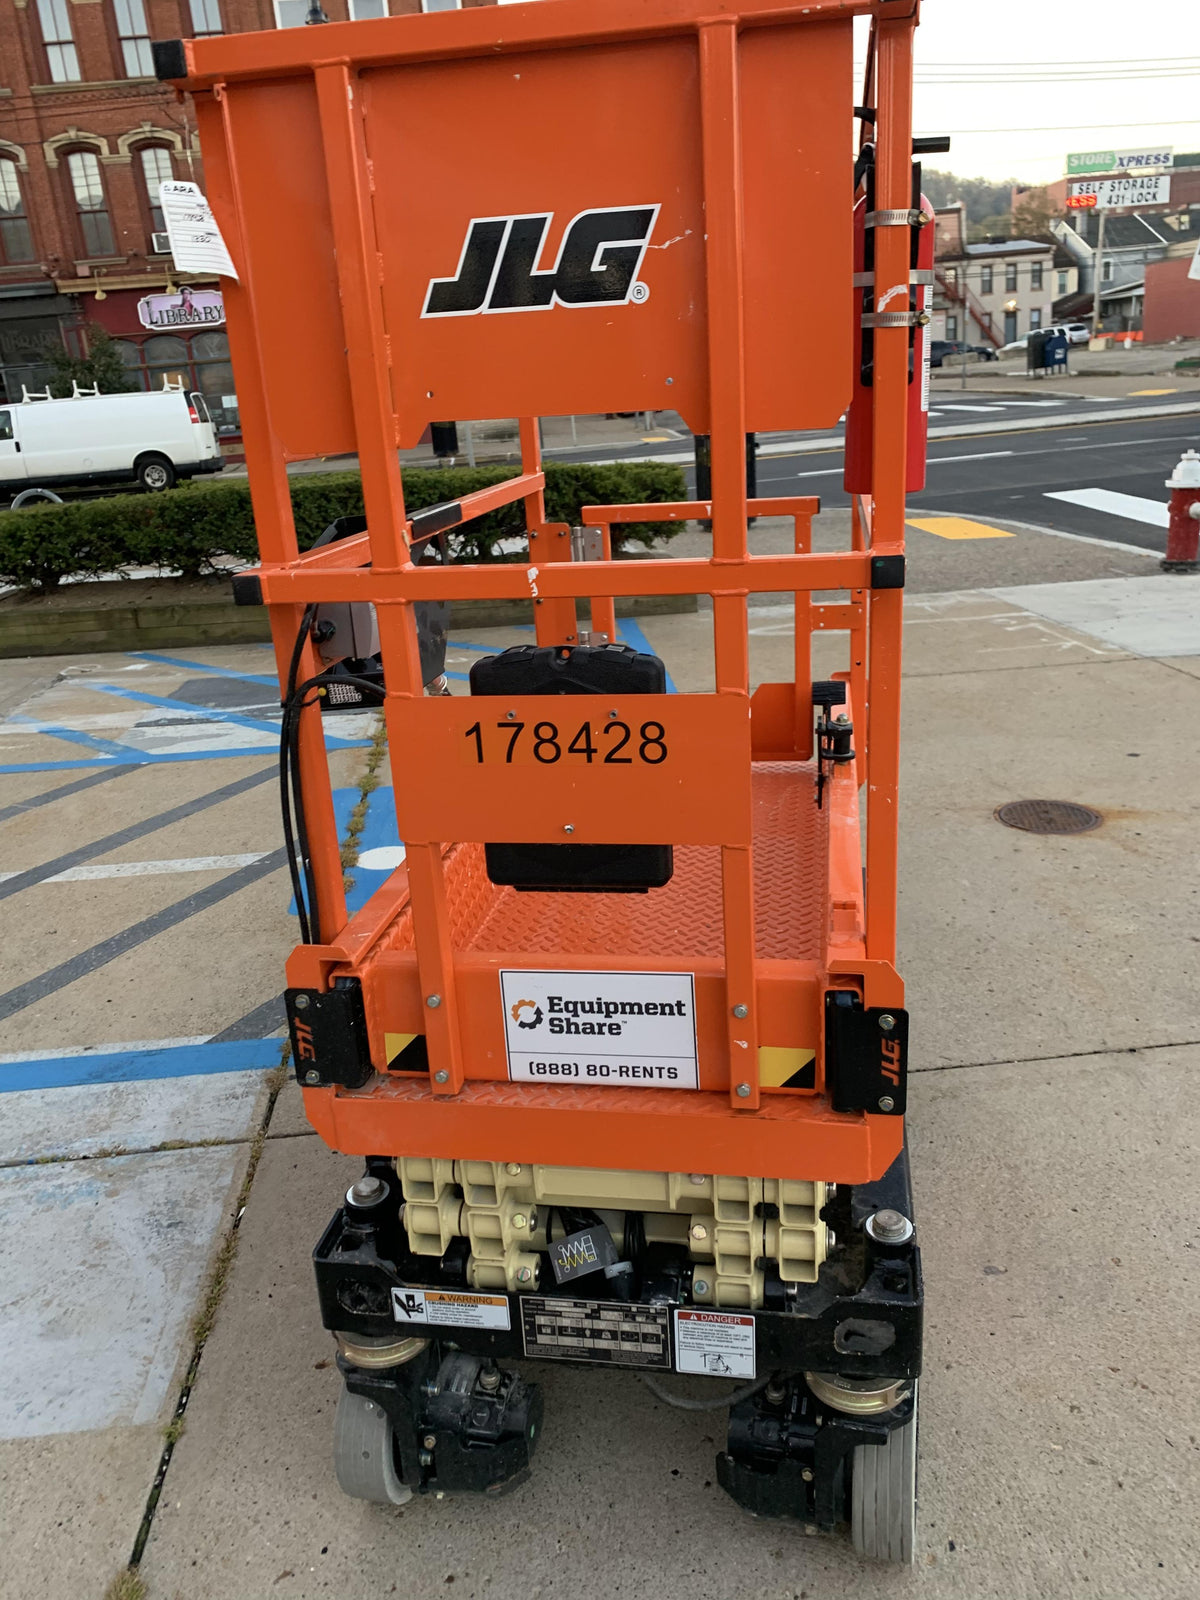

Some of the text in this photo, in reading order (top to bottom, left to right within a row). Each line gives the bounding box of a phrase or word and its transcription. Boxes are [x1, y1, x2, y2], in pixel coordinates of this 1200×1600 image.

[1069, 153, 1171, 167] STORE XPRESS
[1078, 177, 1160, 195] SELF STORAGE
[1106, 191, 1158, 205] 431-LOCK
[145, 301, 223, 325] LIBRARY
[465, 721, 668, 764] 178428
[547, 996, 687, 1018] Equipment
[529, 1061, 678, 1080] (888) 80-RENTS
[447, 1295, 493, 1305] WARNING
[700, 1314, 741, 1324] DANGER
